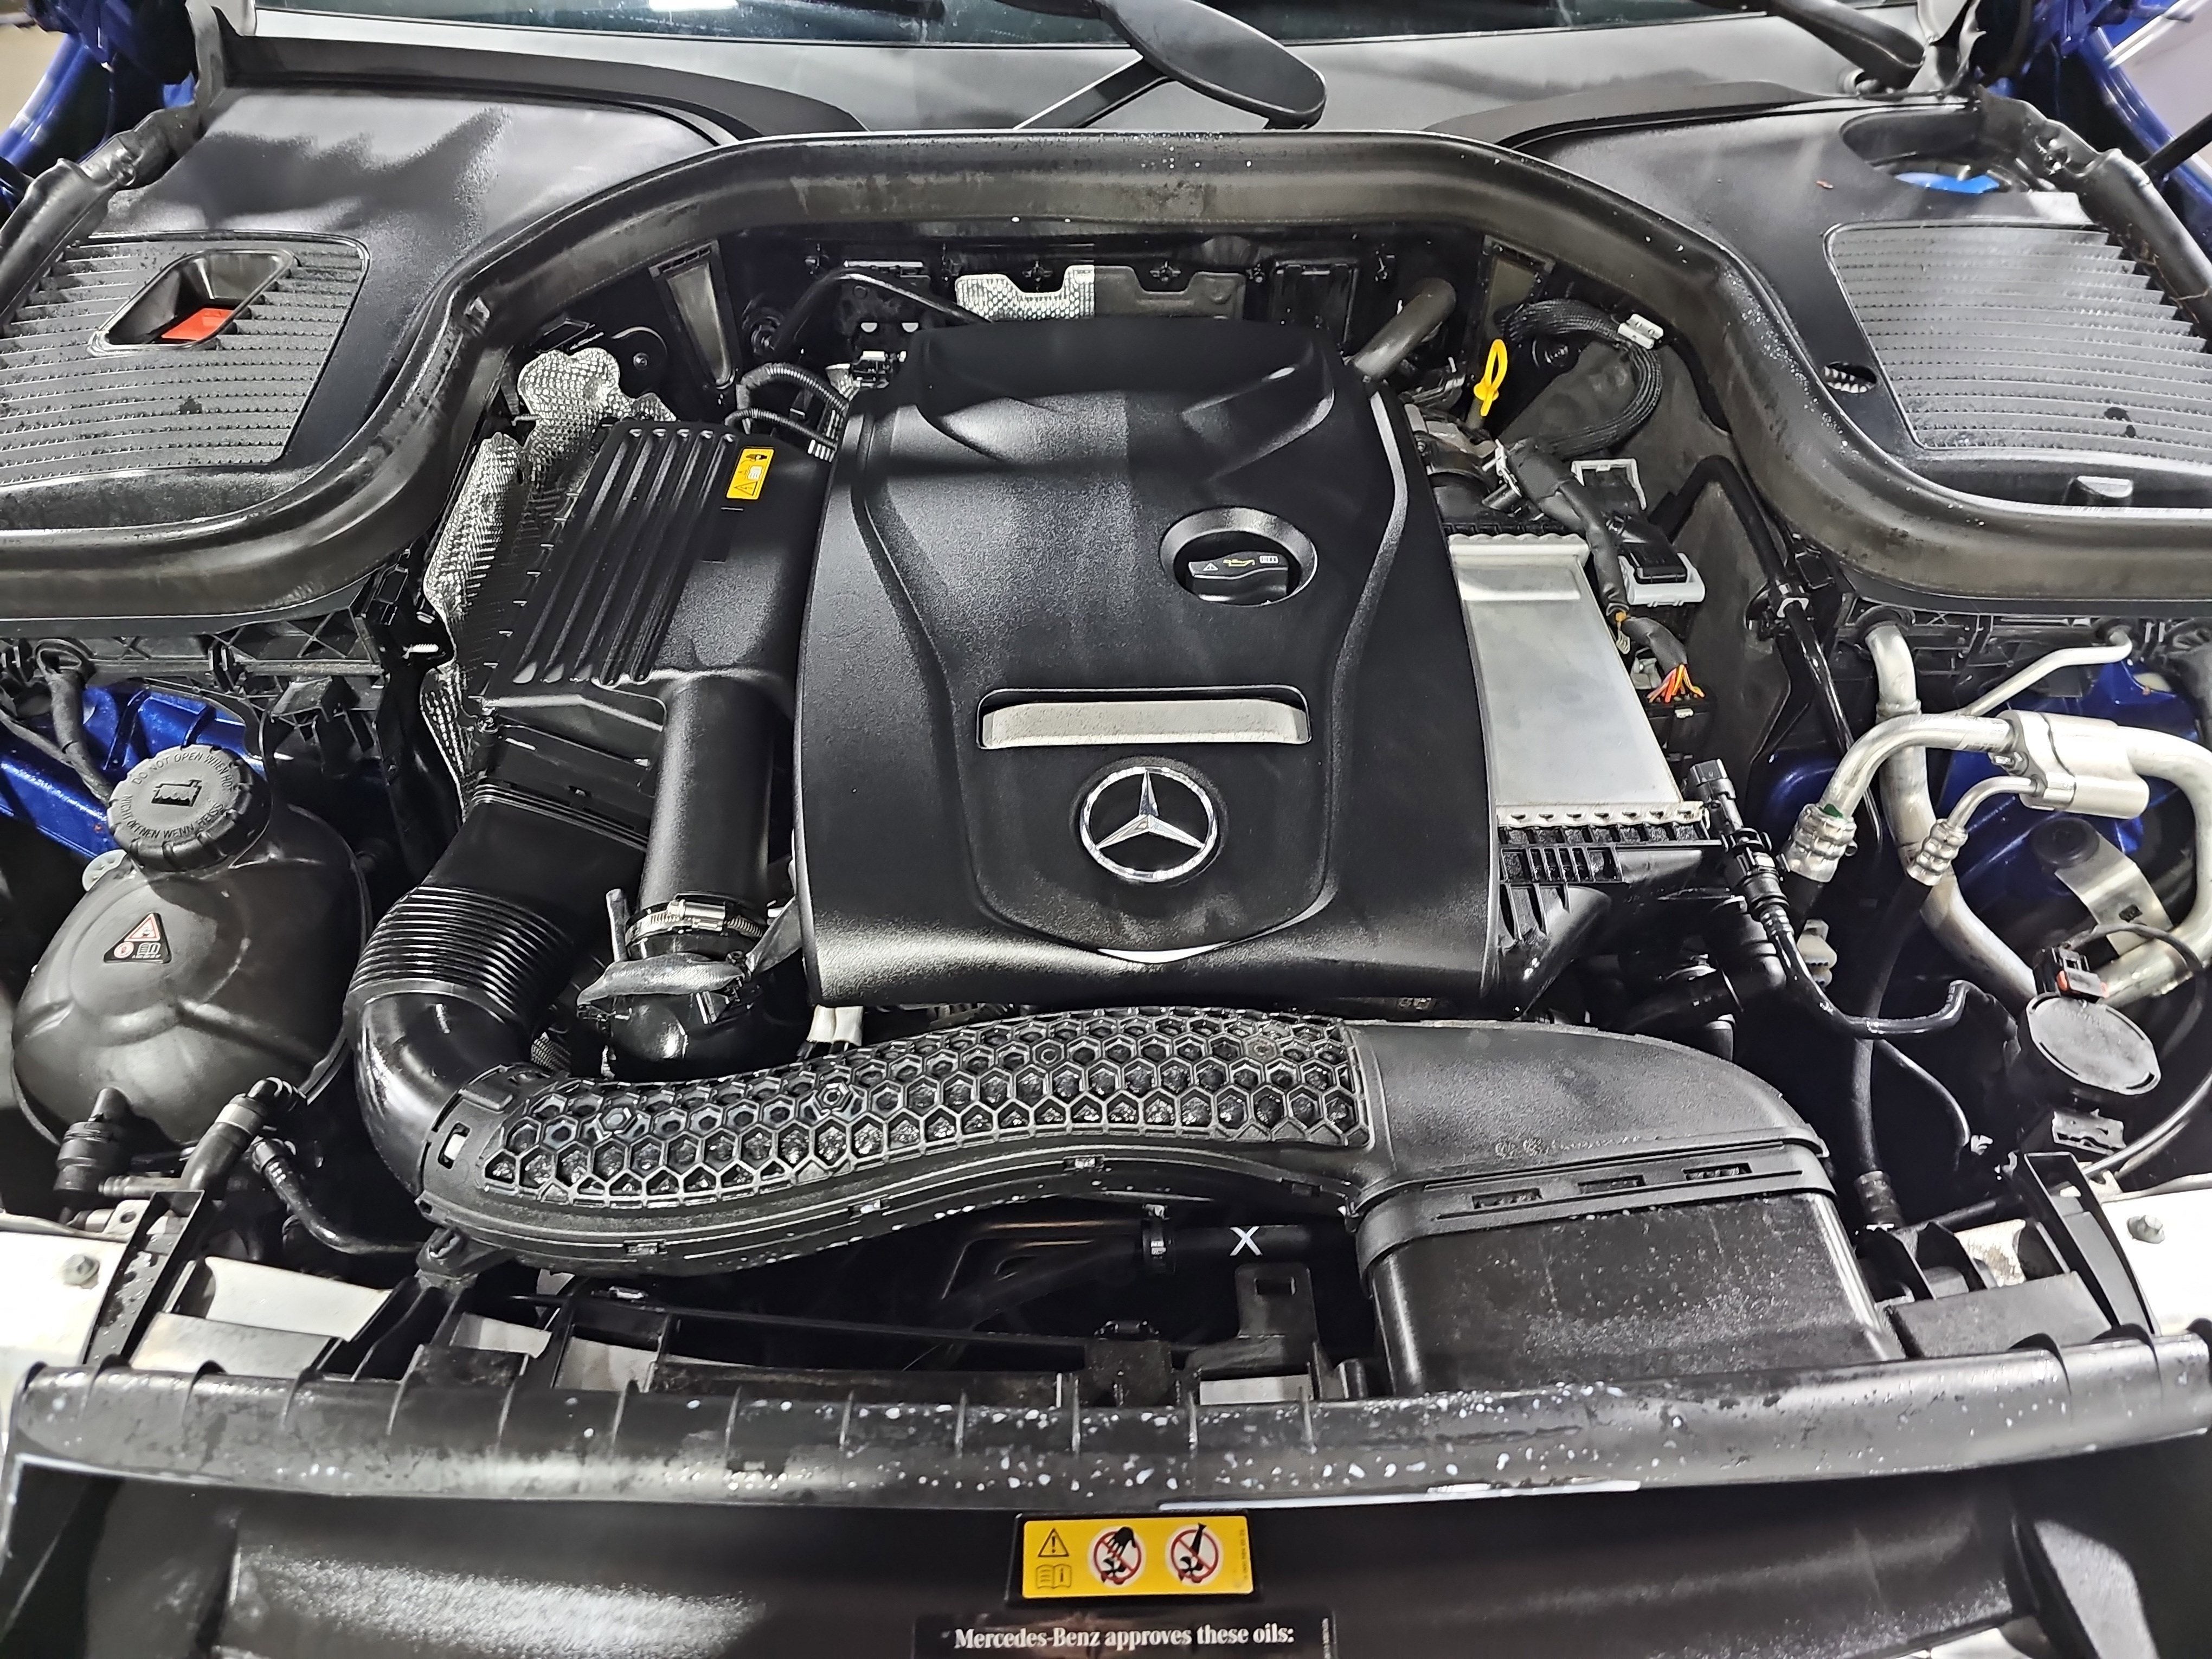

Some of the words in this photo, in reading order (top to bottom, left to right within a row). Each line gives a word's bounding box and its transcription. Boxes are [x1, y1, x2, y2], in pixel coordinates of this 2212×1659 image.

[132, 771, 148, 785] DO
[149, 756, 170, 771] NOT
[173, 752, 203, 762] OPEN
[204, 754, 229, 775] WHEN
[221, 774, 233, 792] HOT
[120, 795, 133, 820] NICHT
[163, 824, 195, 839] WENN
[1230, 1226, 1263, 1256] X
[954, 1627, 1101, 1650] Mercedes-Benz
[1104, 1629, 1192, 1651] approves
[1196, 1624, 1249, 1644] these
[1252, 1623, 1295, 1643] oils:
